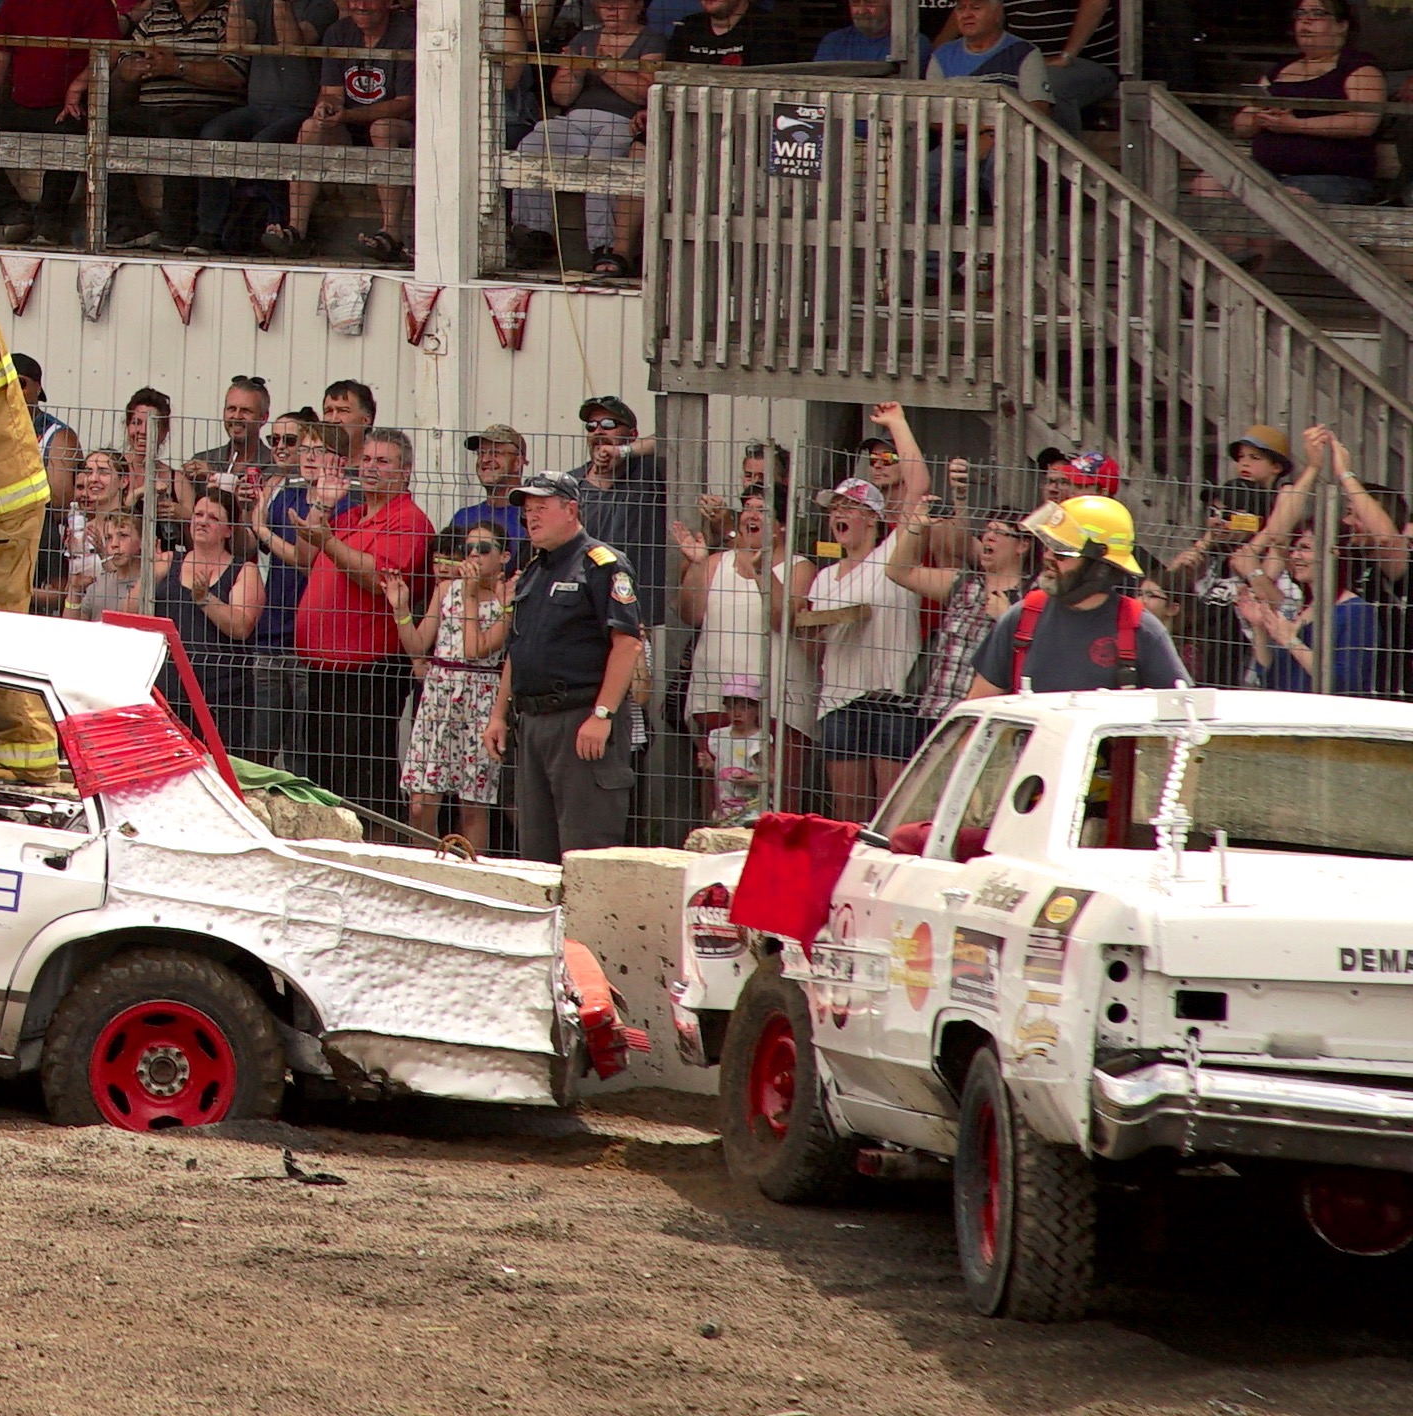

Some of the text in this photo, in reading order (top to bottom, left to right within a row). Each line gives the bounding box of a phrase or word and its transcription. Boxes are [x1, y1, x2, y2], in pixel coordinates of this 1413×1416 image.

[775, 140, 817, 160] Wifi
[774, 157, 820, 168] GRATUIT
[782, 166, 810, 176] FREE
